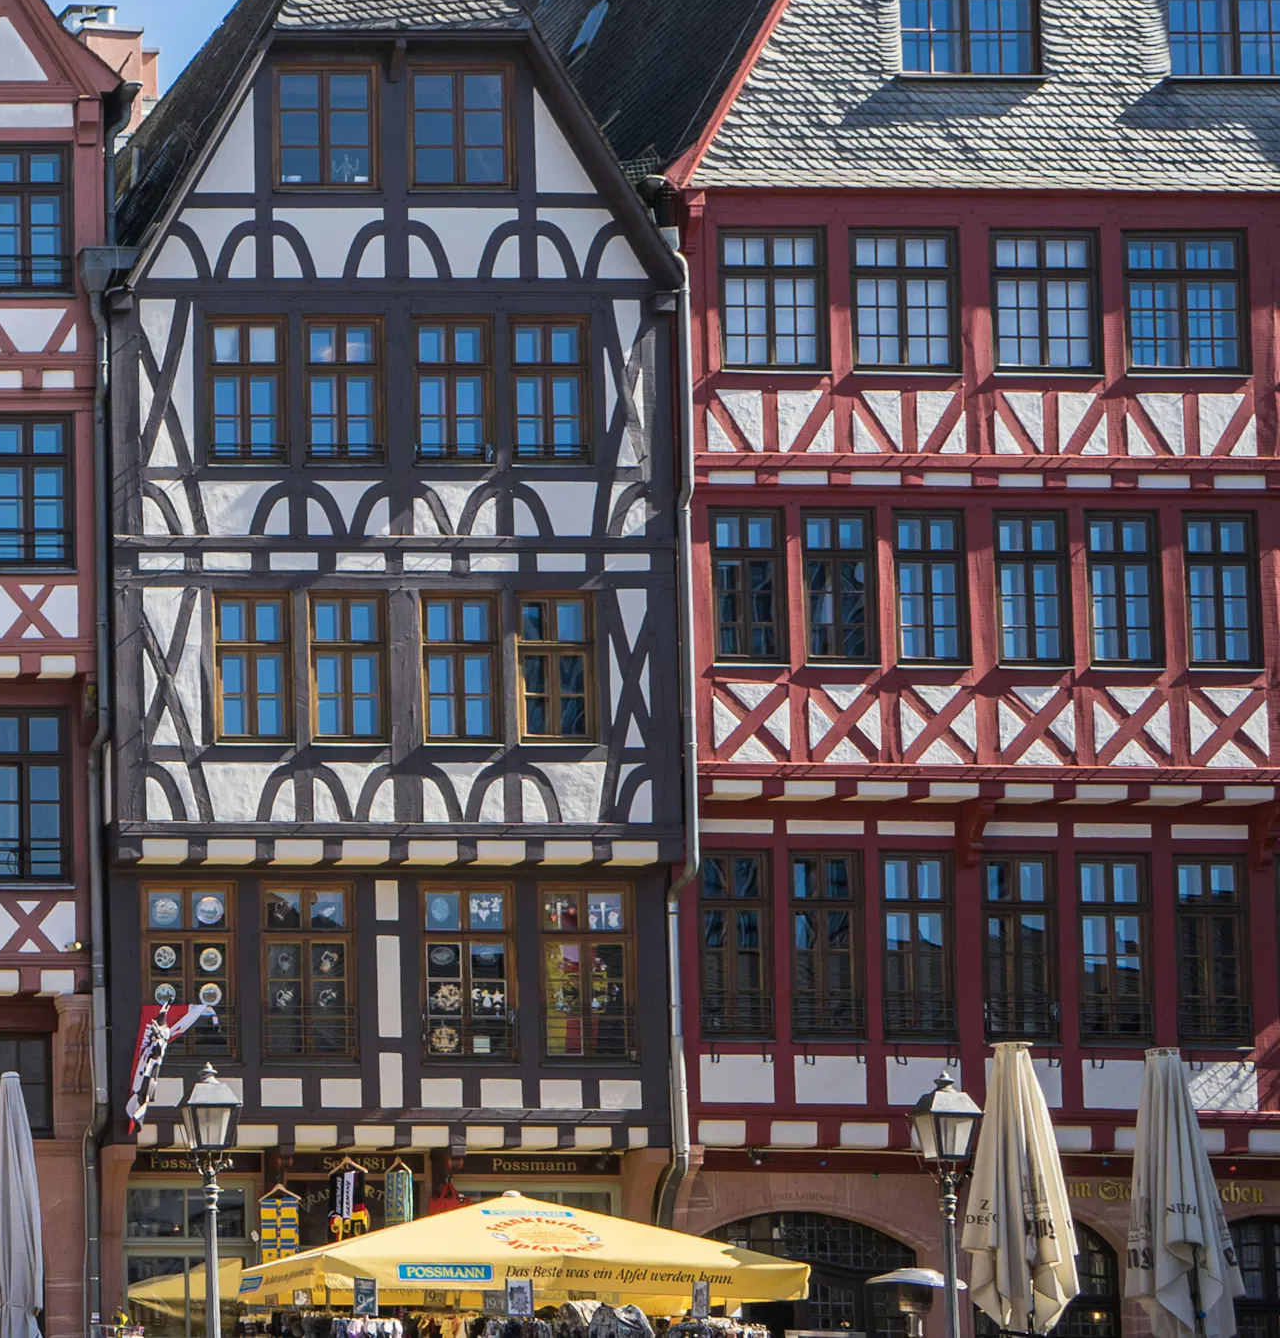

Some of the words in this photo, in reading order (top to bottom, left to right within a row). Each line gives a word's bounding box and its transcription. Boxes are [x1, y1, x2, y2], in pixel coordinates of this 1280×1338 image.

[492, 1158, 577, 1173] Possmann
[486, 1217, 593, 1234] Frankfurter
[406, 1266, 486, 1278] POSSMANN
[506, 1265, 529, 1277] Das
[533, 1265, 563, 1278] Beste
[566, 1269, 590, 1279] was
[593, 1268, 612, 1280] ein
[615, 1268, 648, 1284] Apfel
[650, 1270, 695, 1283] werden
[697, 1270, 734, 1285] kann.
